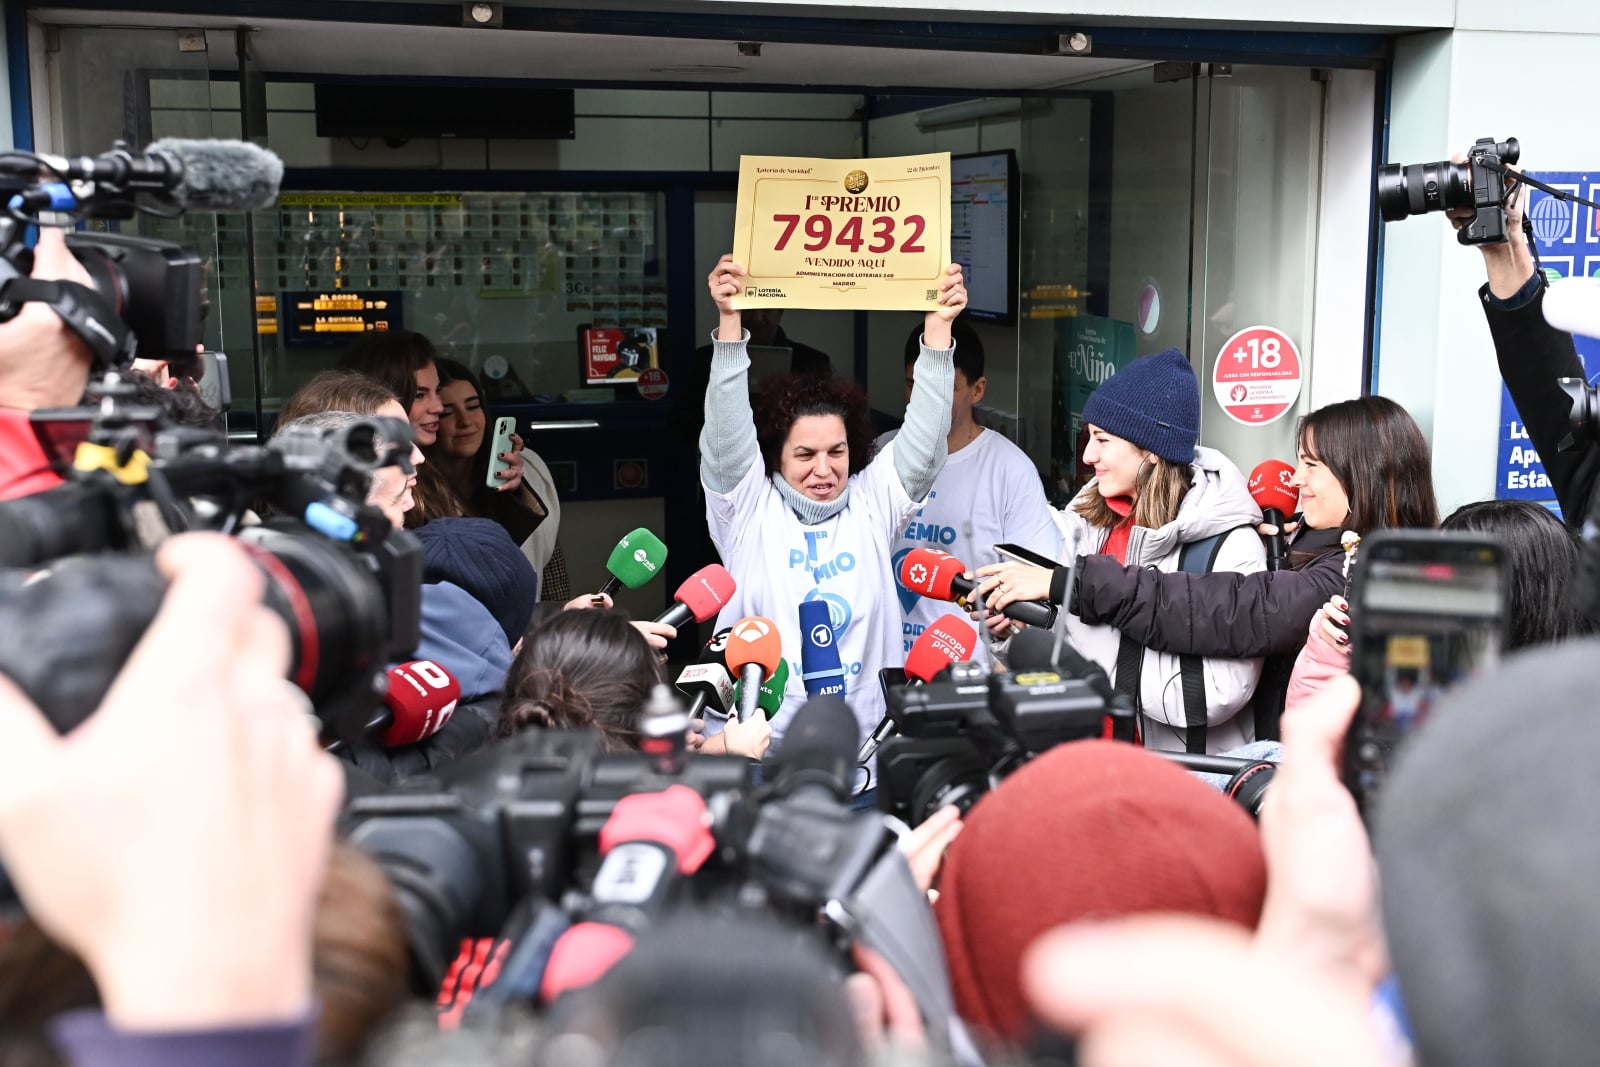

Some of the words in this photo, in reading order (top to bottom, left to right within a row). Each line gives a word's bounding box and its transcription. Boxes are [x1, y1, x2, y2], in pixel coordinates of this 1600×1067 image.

[820, 195, 901, 212] PREMIO
[772, 213, 926, 254] 79432
[804, 256, 854, 268] VENDIDO
[858, 256, 886, 269] AQUÍ
[592, 353, 617, 362] NAVIDAD
[1076, 344, 1116, 385] Niño
[1233, 338, 1282, 368] +18
[932, 640, 960, 663] press
[933, 628, 966, 655] europa
[820, 685, 839, 696] ARD
